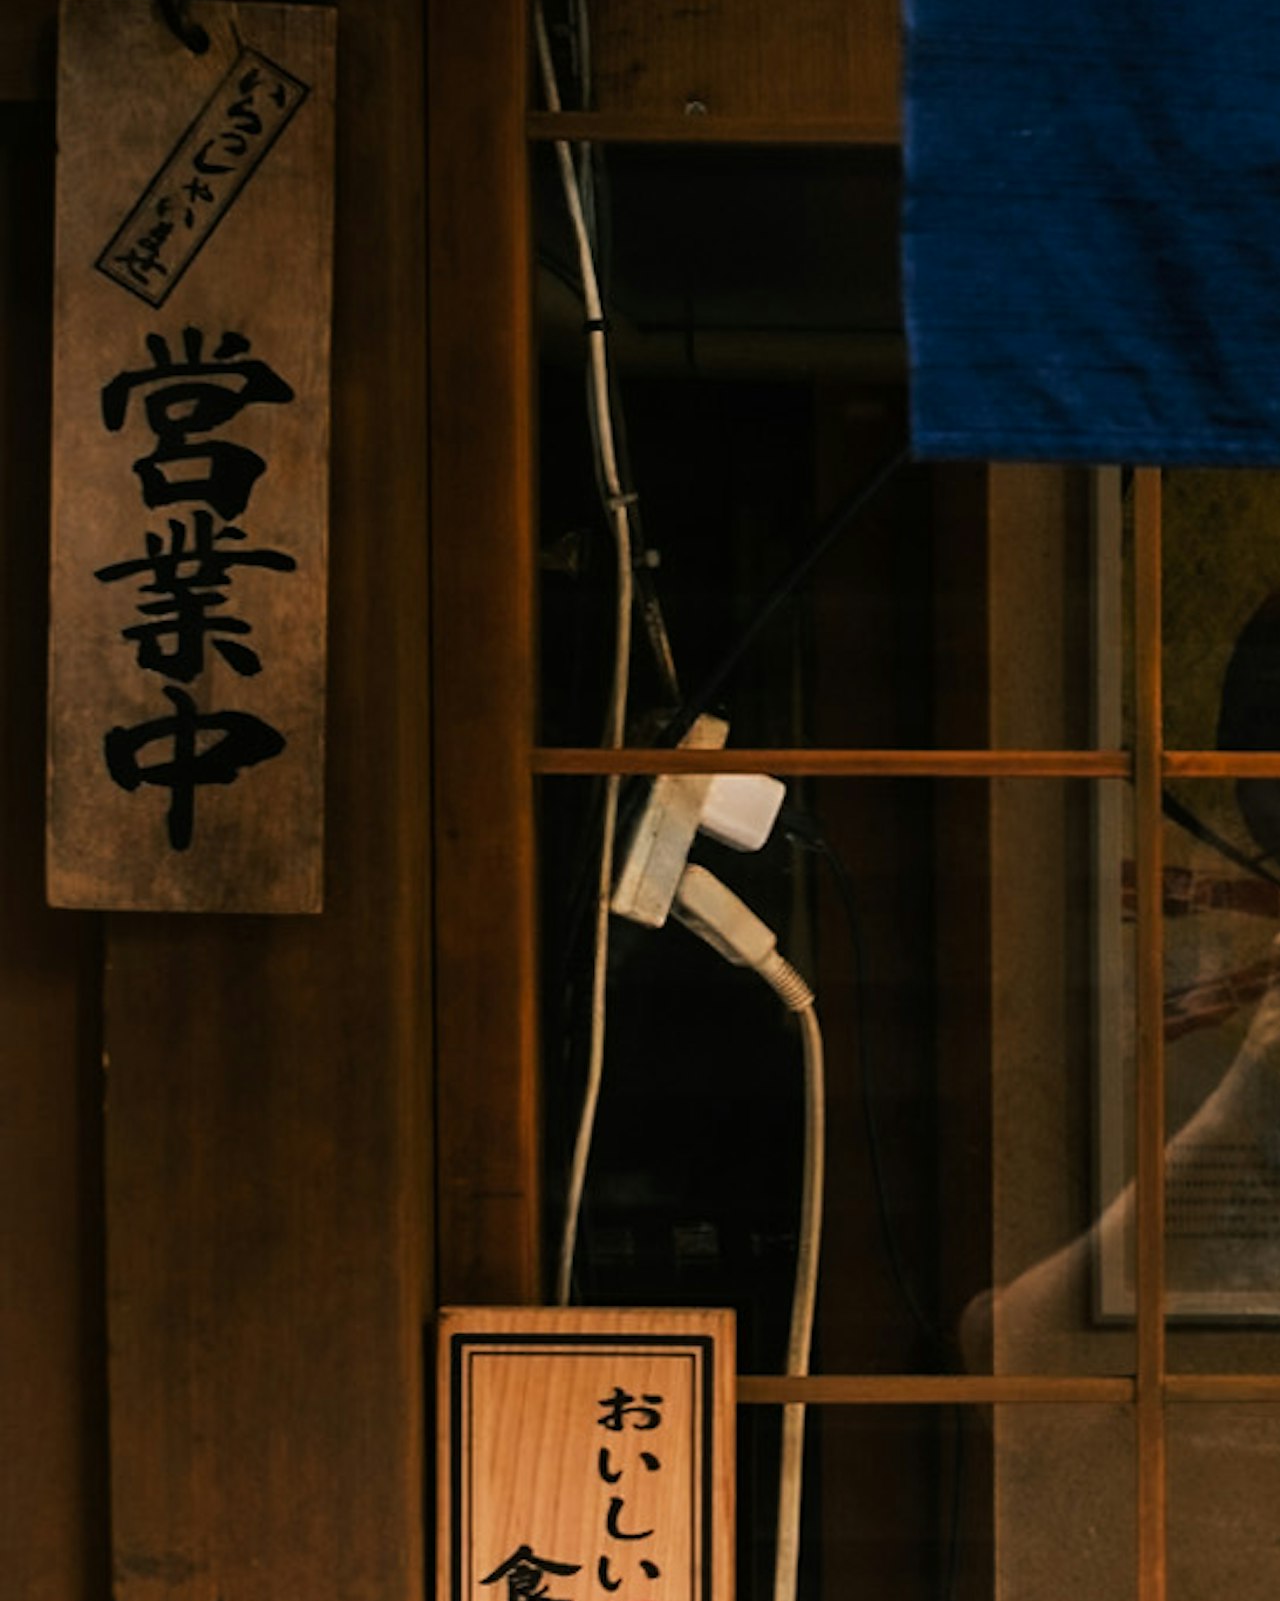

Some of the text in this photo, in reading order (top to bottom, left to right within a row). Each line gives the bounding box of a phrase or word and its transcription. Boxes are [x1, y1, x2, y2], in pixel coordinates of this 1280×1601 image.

[112, 67, 287, 286] いらっしゃいませ
[93, 325, 299, 852] 営業中
